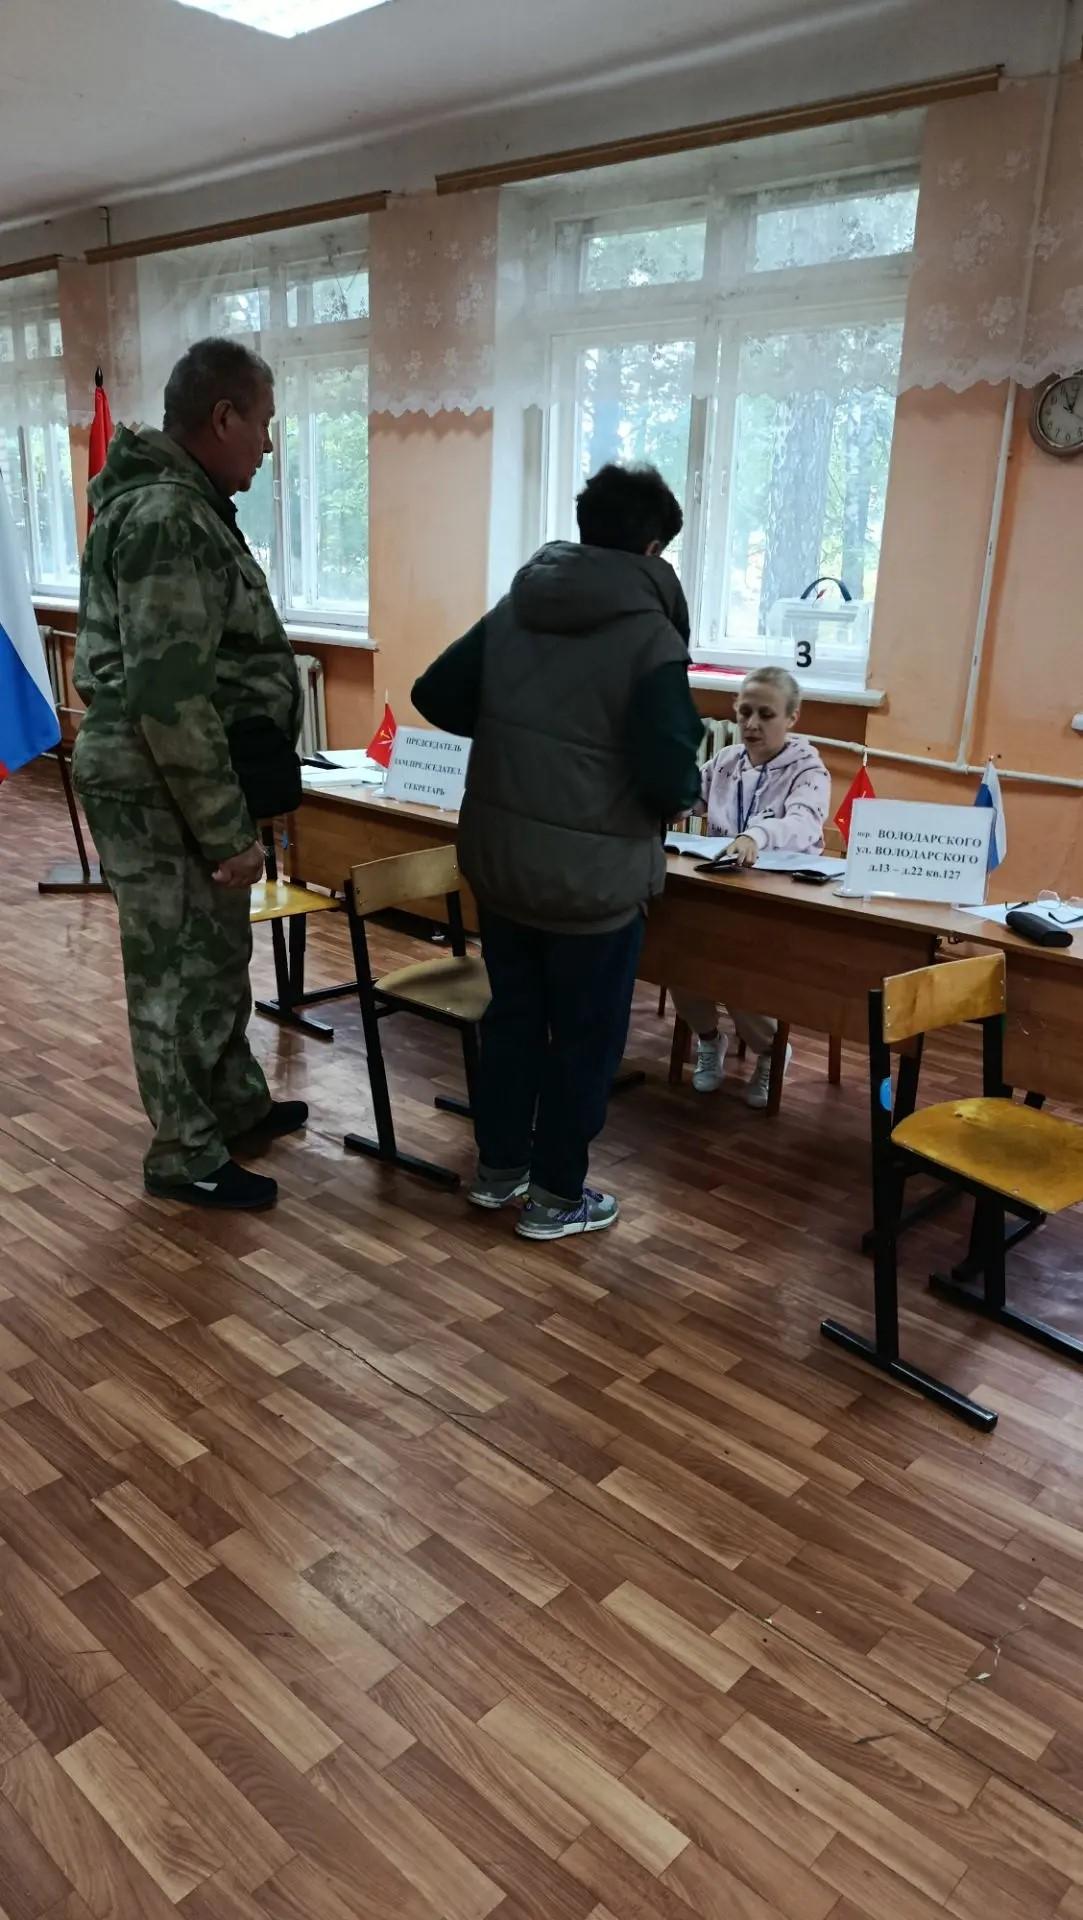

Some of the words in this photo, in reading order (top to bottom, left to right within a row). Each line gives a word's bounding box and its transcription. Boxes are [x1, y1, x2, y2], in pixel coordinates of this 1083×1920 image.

[796, 640, 812, 668] 3
[406, 736, 462, 751] ПРЕДСЕДАТЕЛЬ
[403, 782, 445, 796] СЕКРЕТАРЬ
[878, 829, 982, 848] ВОЛОДАРСКОГО
[856, 846, 872, 855] ул.
[875, 846, 979, 864] ВОЛОДАРСКОГО
